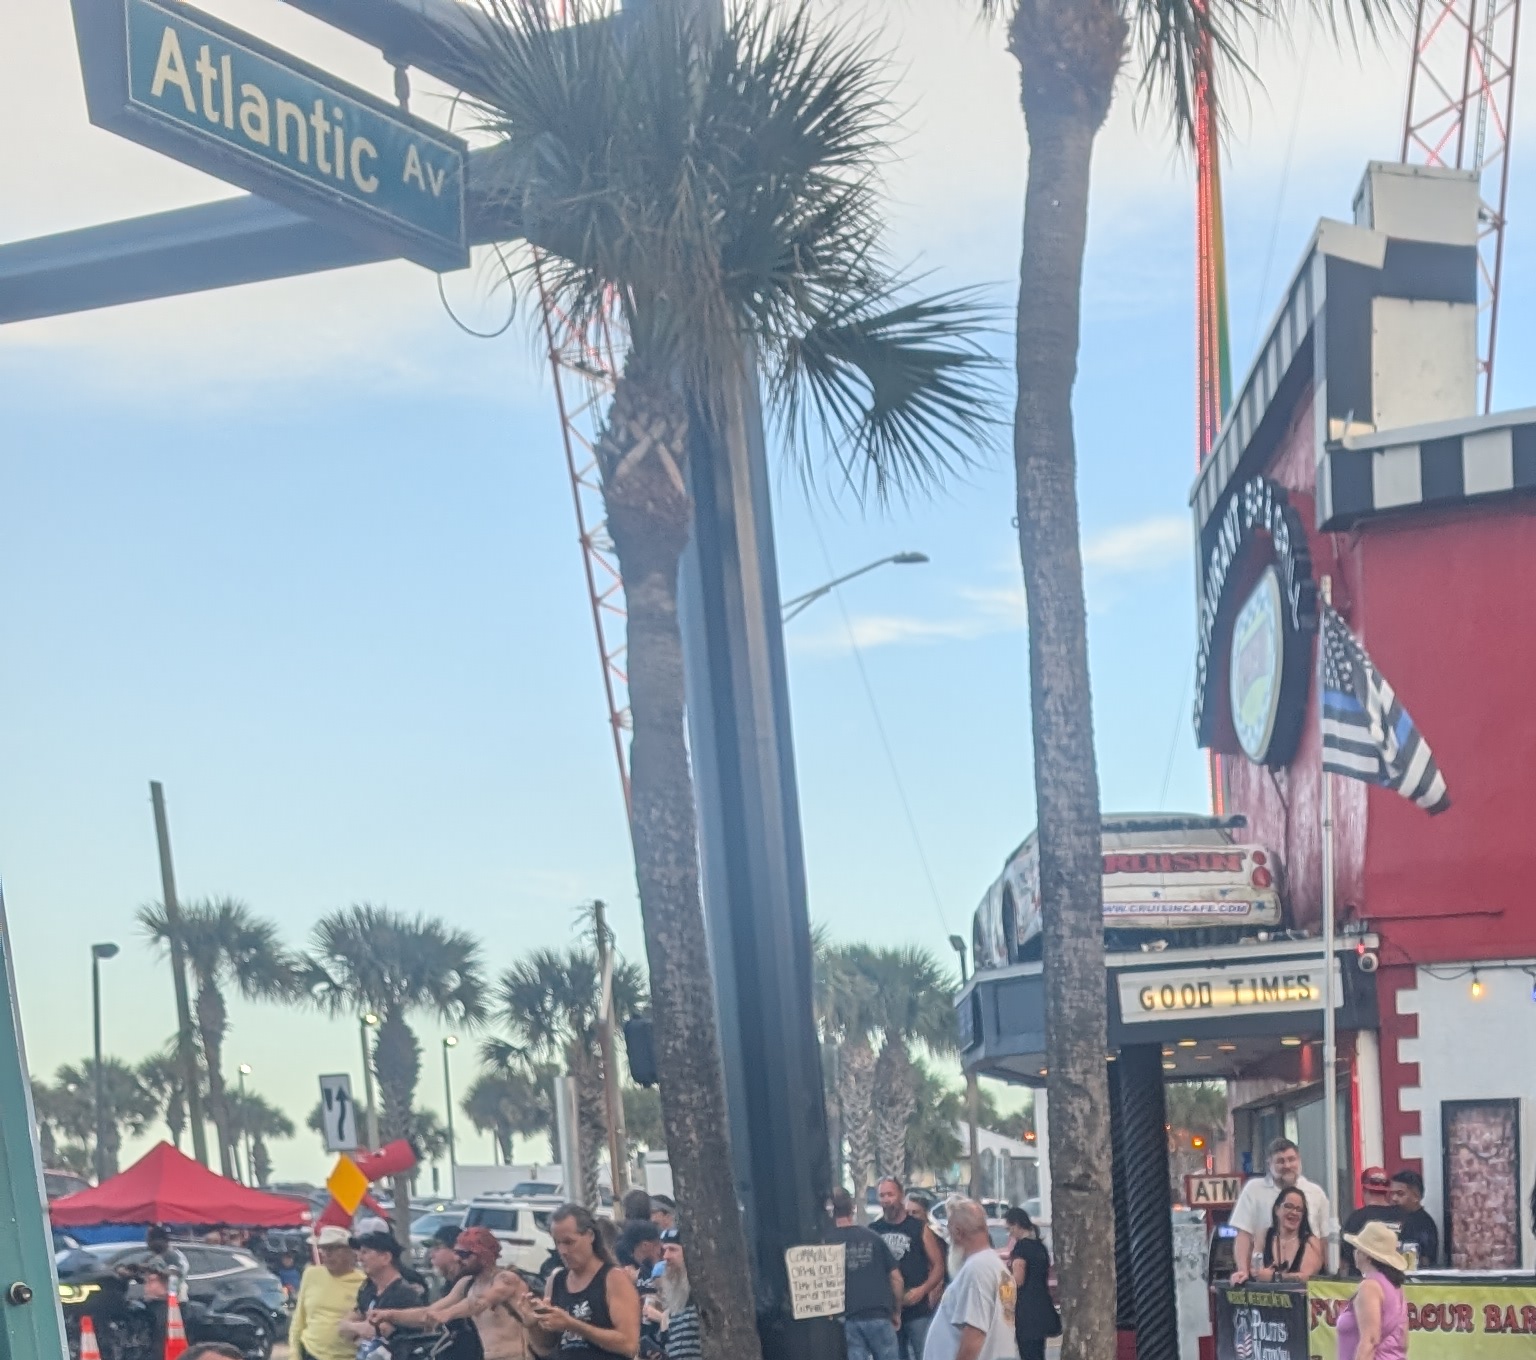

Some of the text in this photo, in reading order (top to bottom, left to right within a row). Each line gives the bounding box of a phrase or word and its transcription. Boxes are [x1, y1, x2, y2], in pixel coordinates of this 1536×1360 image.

[151, 26, 446, 198] Atlantic Av
[1139, 974, 1312, 1010] GOOD TIMES
[1194, 1179, 1239, 1202] ATM
